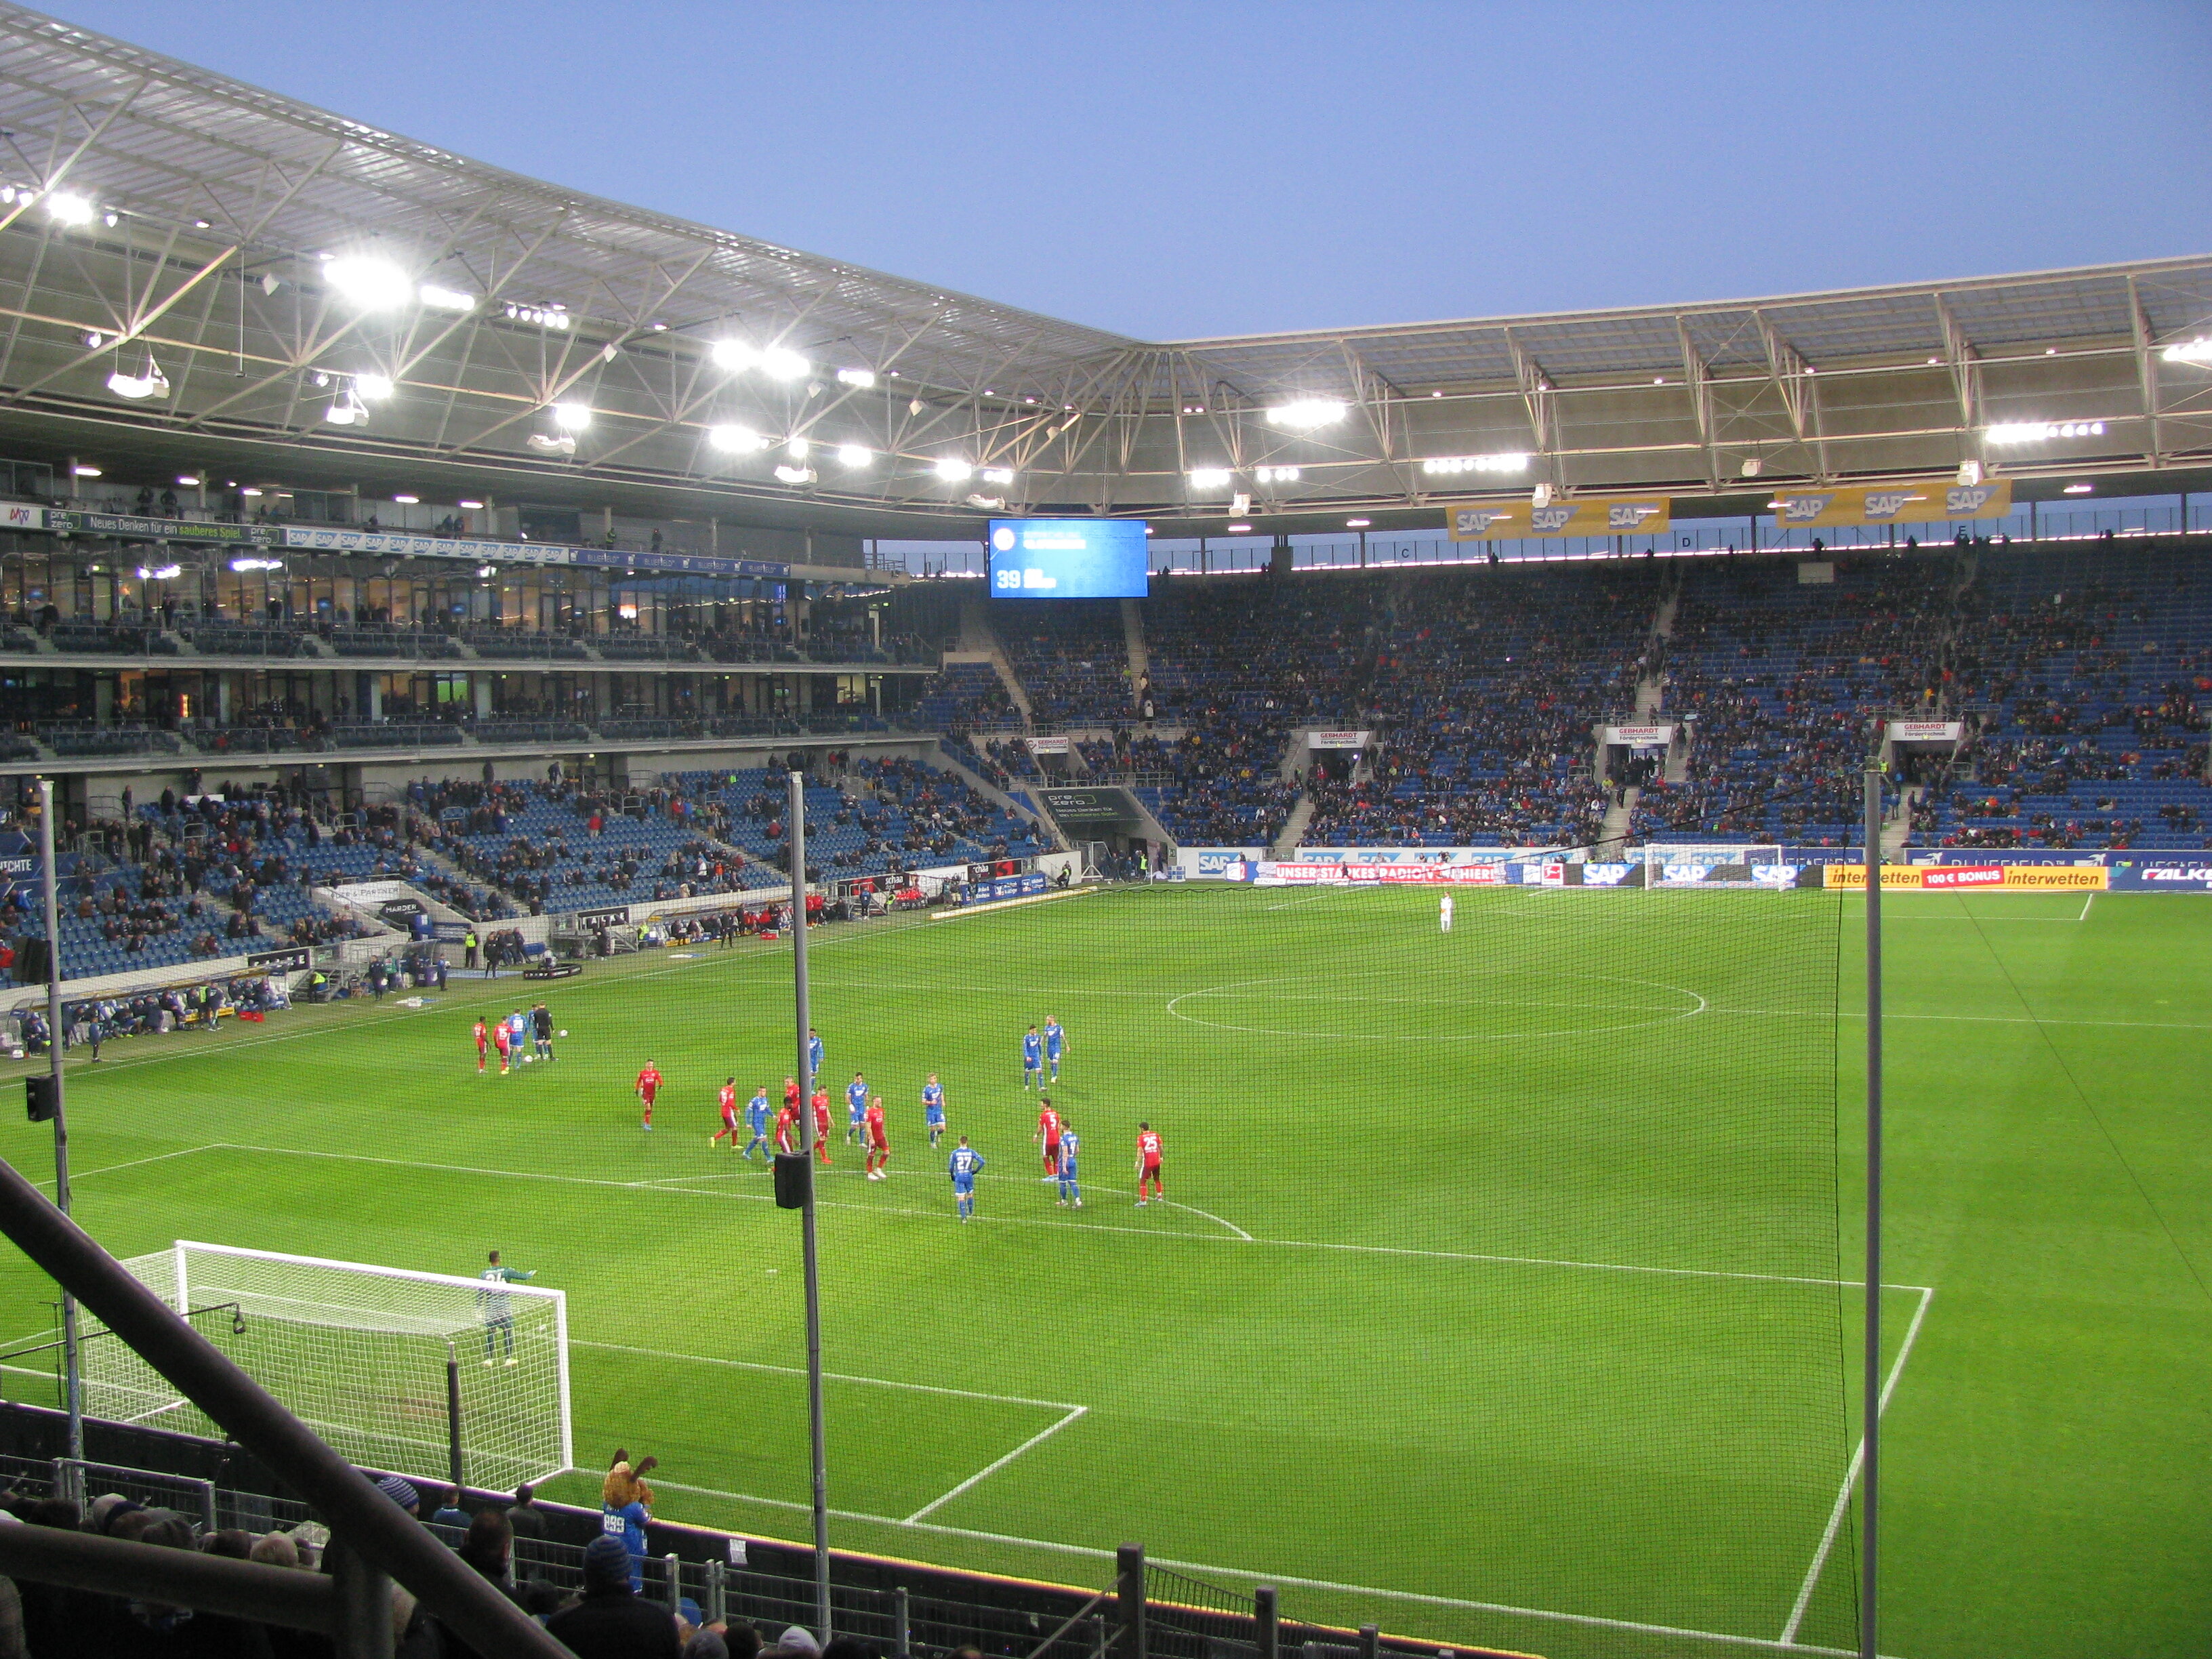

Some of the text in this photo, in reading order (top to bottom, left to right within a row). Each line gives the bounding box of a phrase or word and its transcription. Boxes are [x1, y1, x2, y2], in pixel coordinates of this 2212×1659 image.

[1864, 496, 1903, 515] SAP
[1946, 491, 1986, 510] SAP
[1786, 499, 1822, 518] SAP
[51, 511, 67, 519] pre
[1532, 511, 1568, 529] SAP
[1609, 508, 1647, 525] SAP
[51, 520, 73, 529] zero
[1457, 514, 1491, 531] SAP
[91, 517, 243, 541] Neues Denken für ein sauberes Spiel.
[251, 527, 266, 536] pre
[1959, 525, 1966, 535] E
[251, 535, 271, 544] zero
[290, 532, 307, 542] SAP
[316, 534, 333, 544] SAP
[341, 535, 358, 546] SAP
[365, 537, 382, 547] SAP
[1682, 537, 1691, 547] D
[390, 539, 406, 549] SAP
[413, 541, 429, 551] SAP
[437, 543, 452, 552] SAP
[459, 544, 474, 554] SAP
[481, 546, 495, 556] SAP
[504, 547, 518, 557] SAP
[525, 549, 539, 558] SAP
[546, 550, 559, 560] SAP
[1401, 548, 1409, 558] C
[997, 570, 1021, 589] 39
[972, 864, 989, 873] chaa
[1199, 856, 1231, 871] SAP
[1276, 867, 1317, 878] UNSER
[1379, 868, 1422, 880] RADIO
[1460, 868, 1494, 879] HIER!
[1583, 865, 1625, 884] SAP
[1663, 865, 1706, 881] SAP
[1752, 865, 1796, 882] SAP
[1832, 869, 1919, 884] interetten
[1926, 870, 2000, 884] 100 € BONUS
[2007, 870, 2099, 885] interwetten
[361, 887, 398, 895] PARTNER
[386, 903, 417, 913] HARDER
[1050, 1114, 1057, 1127] 5
[1143, 1136, 1157, 1151] 25
[957, 1156, 972, 1170] 27
